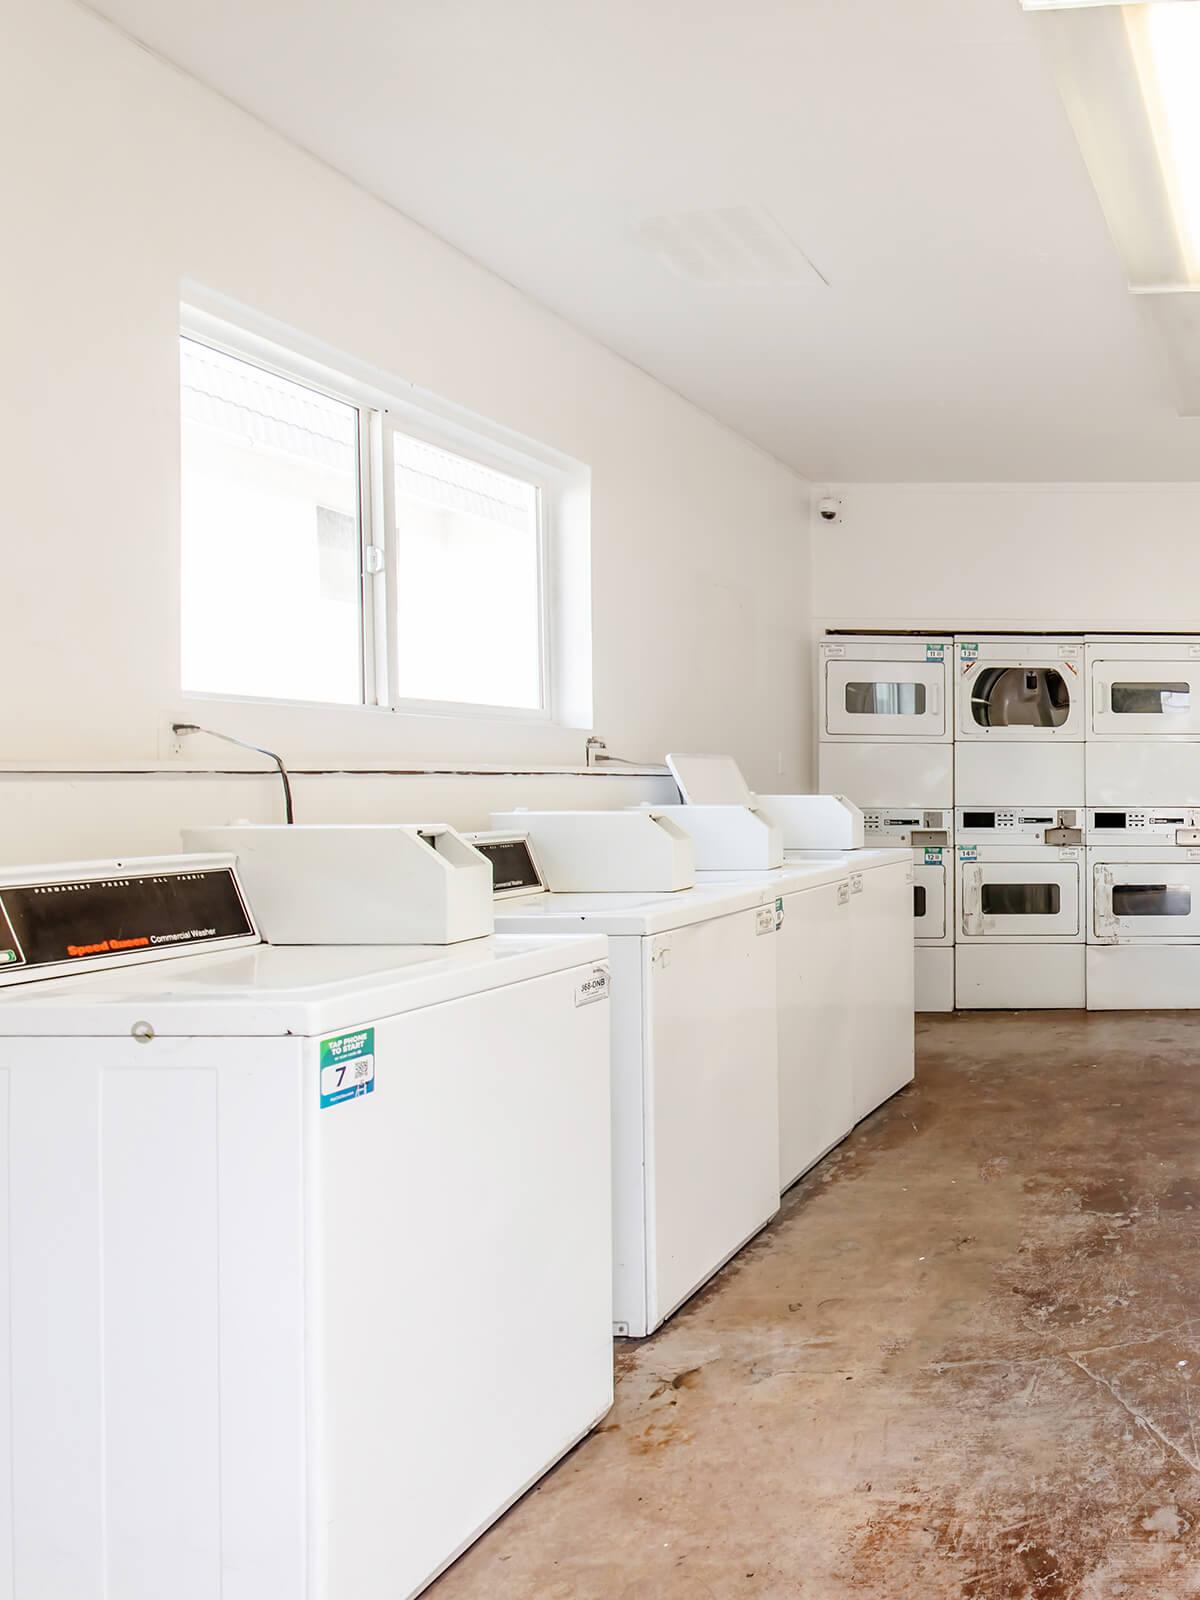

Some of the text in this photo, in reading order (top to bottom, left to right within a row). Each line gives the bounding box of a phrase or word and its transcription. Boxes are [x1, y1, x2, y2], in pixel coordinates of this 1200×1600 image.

[67, 928, 216, 957] Speed Queen Commercial Washer
[329, 1033, 367, 1049] TAP PHONE
[332, 1048, 342, 1056] TO
[343, 1041, 364, 1052] START
[335, 1066, 346, 1087] 7
